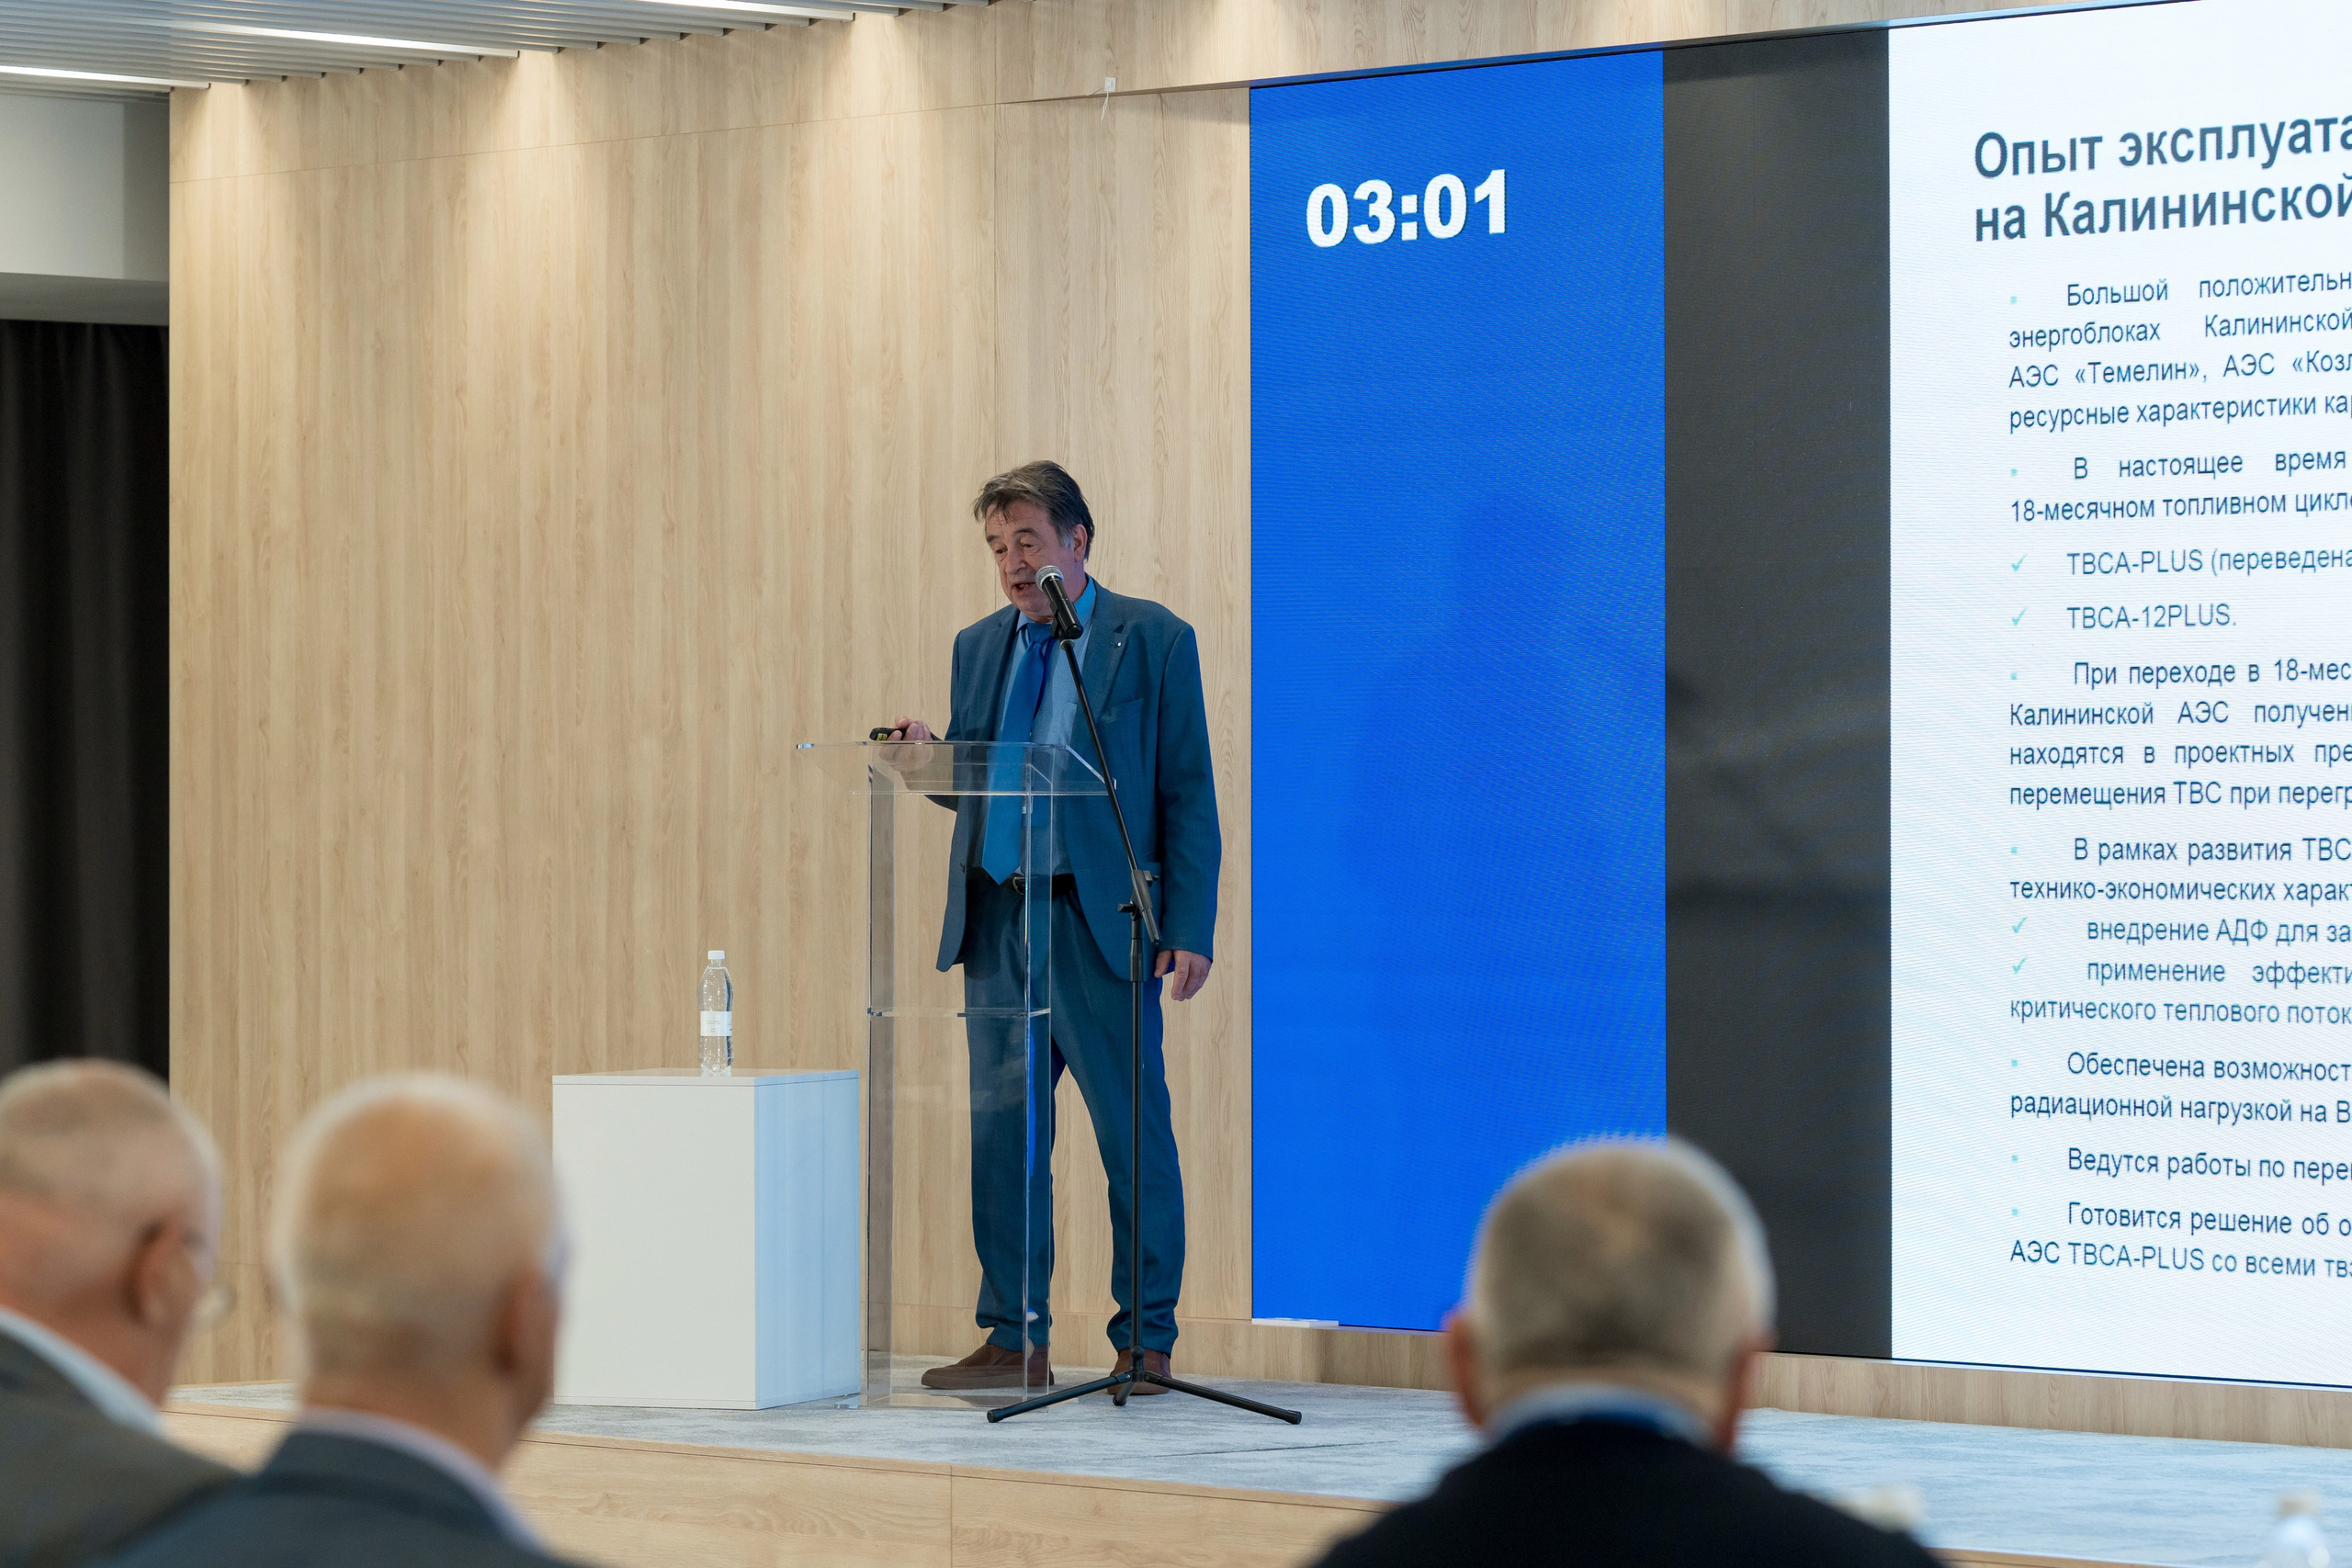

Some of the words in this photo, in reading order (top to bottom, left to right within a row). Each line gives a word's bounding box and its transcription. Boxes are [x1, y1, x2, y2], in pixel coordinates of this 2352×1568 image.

[1974, 131, 2104, 180] Опыт
[1306, 169, 1506, 248] 03:01
[1975, 204, 2027, 243] на
[2067, 278, 2168, 307] Большой
[2008, 321, 2161, 353] энергоблоках
[2008, 364, 2059, 389] АЭС
[2075, 361, 2207, 384] «Темелин»,
[2222, 352, 2275, 378] АЭС
[2009, 405, 2130, 435] ресурсные
[2136, 396, 2316, 428] характеристики
[2324, 394, 2352, 418] ка
[2074, 457, 2088, 479] В
[2119, 455, 2244, 480] настоящее
[2275, 450, 2346, 478] время
[2011, 499, 2155, 523] 18-месячном
[2162, 494, 2287, 517] топливном
[2295, 491, 2352, 518] цикл
[2074, 661, 2117, 691] При
[2129, 664, 2236, 690] переходе
[2247, 663, 2260, 682] в
[2010, 702, 2154, 727] Калининской
[2177, 700, 2229, 725] АЭС
[2254, 704, 2352, 729] получен
[2009, 745, 2124, 769] находятся
[2143, 745, 2155, 764] в
[2175, 744, 2295, 770] проектных
[2009, 786, 2165, 811] перемещения
[2173, 780, 2222, 805] ТВС
[2230, 785, 2270, 810] при
[2074, 837, 2088, 861] В
[2098, 841, 2178, 866] рамках
[2188, 841, 2292, 866] развития
[2009, 881, 2276, 901] технико-экономических
[2086, 921, 2210, 946] внедрение
[2215, 918, 2268, 947] АДФ
[2275, 923, 2319, 947] для
[2086, 962, 2226, 987] применение
[2010, 999, 2157, 1024] критического
[2163, 1002, 2280, 1023] теплового
[2067, 1051, 2205, 1078] Обеспечена
[2010, 1094, 2173, 1122] радиационной
[2180, 1099, 2292, 1126] нагрузкой
[2301, 1104, 2327, 1122] на
[2068, 1146, 2159, 1179] Ведутся
[2167, 1151, 2251, 1180] работы
[2258, 1158, 2285, 1179] по
[2293, 1160, 2352, 1187] пере
[2068, 1201, 2181, 1229] Готовится
[2190, 1212, 2292, 1236] решение
[2301, 1212, 2330, 1236] об
[2009, 1239, 2061, 1265] АЭС
[2211, 1253, 2238, 1273] со
[2245, 1255, 2316, 1277] всеми
[2324, 1258, 2352, 1279] тв
